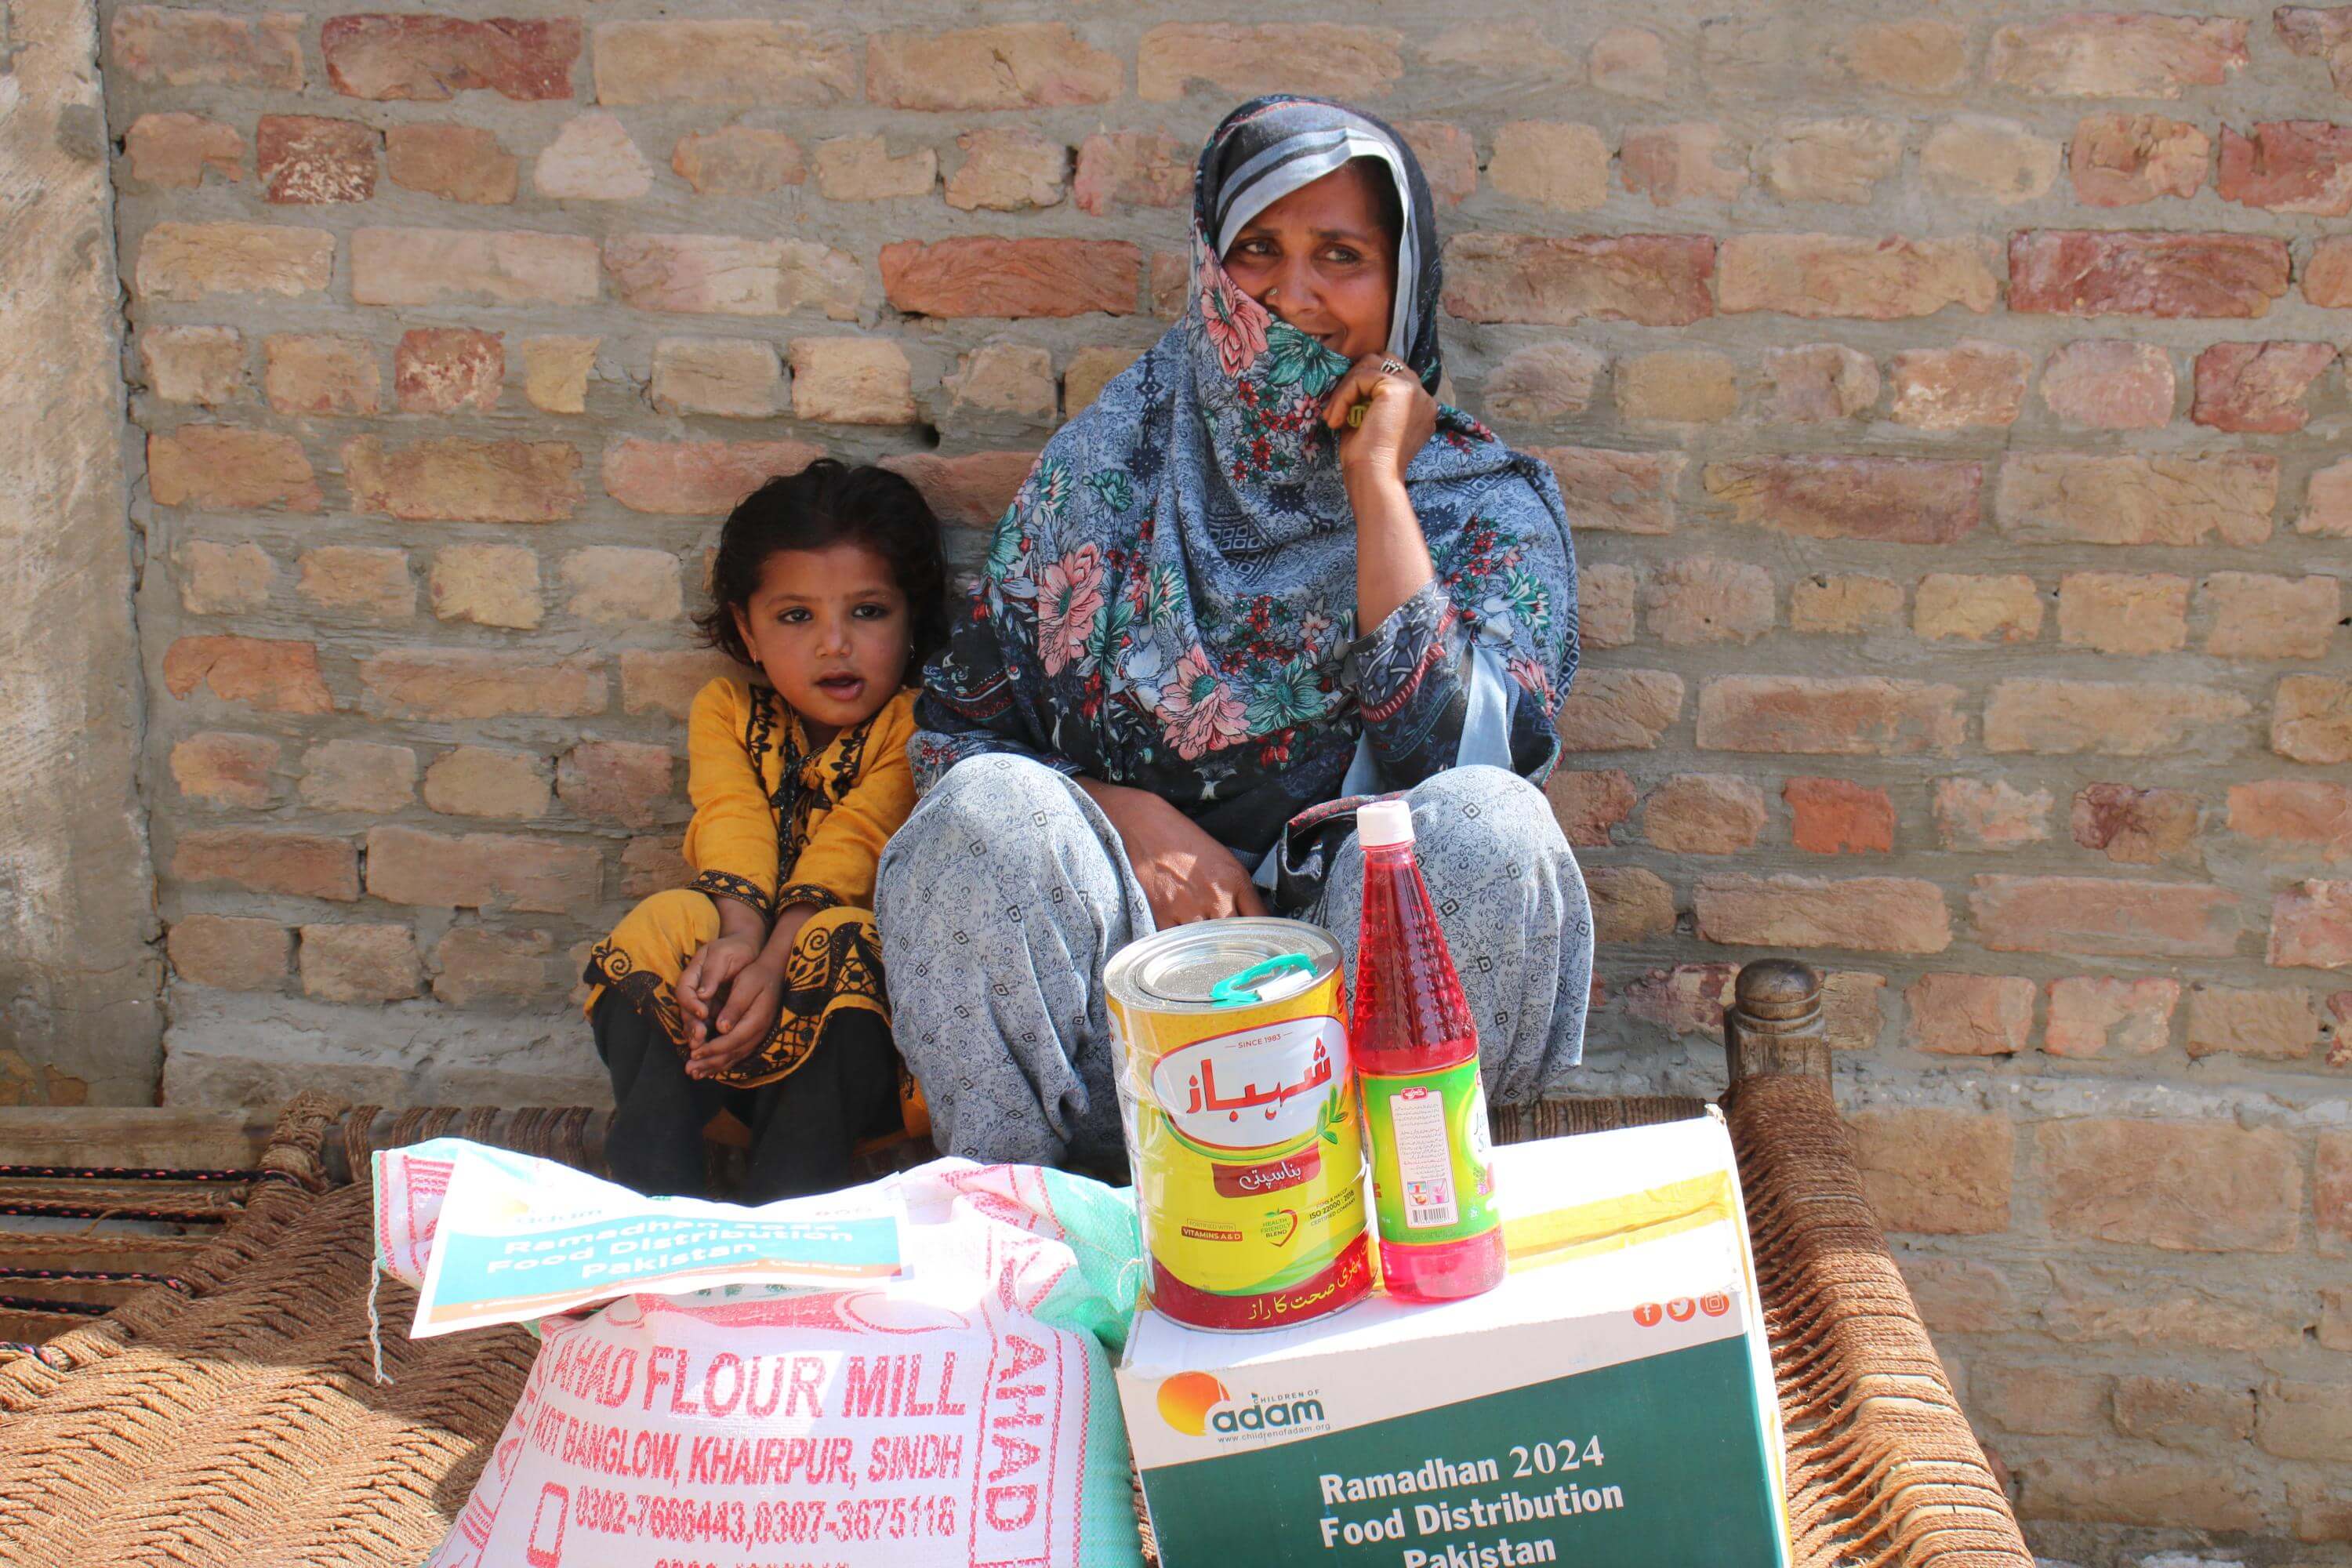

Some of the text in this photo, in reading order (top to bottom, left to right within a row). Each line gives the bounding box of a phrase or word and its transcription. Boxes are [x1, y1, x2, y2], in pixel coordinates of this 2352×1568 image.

[1238, 1033, 1281, 1049] SINCE 1983
[1309, 1210, 1322, 1220] ISO
[1322, 1200, 1341, 1214] 22000
[1343, 1189, 1355, 1202] 2018
[1183, 1228, 1219, 1240] VITAMINS
[1261, 1222, 1291, 1233] FRIENDLY
[1262, 1218, 1287, 1227] HEALTH
[1265, 1229, 1287, 1238] BLEND
[487, 1247, 594, 1274] Food
[610, 1229, 853, 1254] Distribution
[582, 1243, 757, 1279] Pakistan
[1248, 1298, 1271, 1319] راز
[1273, 1294, 1287, 1313] کا
[1290, 1283, 1335, 1308] صحت
[642, 1345, 827, 1419] FLOUR
[841, 1351, 967, 1418] MILL
[1254, 1391, 1305, 1404] CHILDREN
[1212, 1399, 1325, 1433] adam
[985, 1334, 1047, 1532] AHAD
[1218, 1423, 1331, 1443] www.childrenofadam.org
[688, 1435, 857, 1491] KHAIRPUR,
[868, 1433, 964, 1483] SINDH
[1319, 1435, 1605, 1505] Ramadhan 2024
[1319, 1483, 1624, 1548] Food Distribution
[1403, 1537, 1557, 1568] Pakistan
